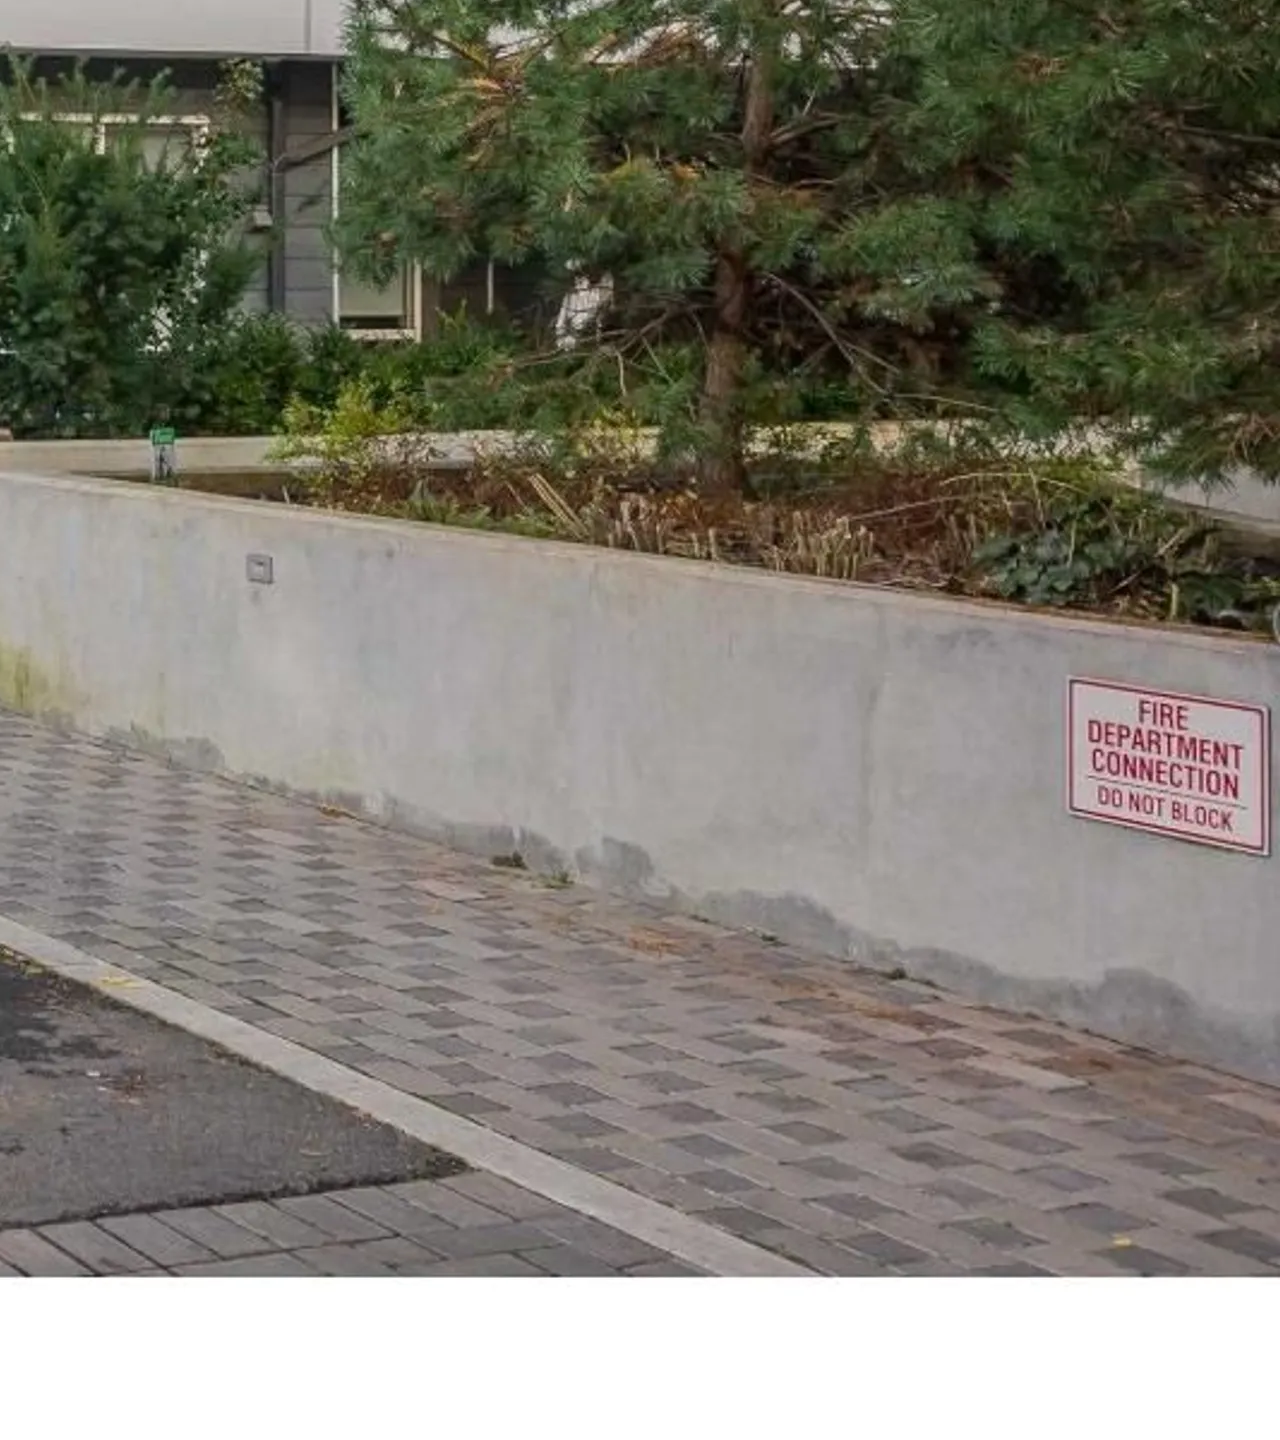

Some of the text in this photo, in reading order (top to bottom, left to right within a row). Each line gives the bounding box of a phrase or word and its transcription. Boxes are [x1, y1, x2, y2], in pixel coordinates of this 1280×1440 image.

[1139, 700, 1188, 730] FIRE
[1088, 720, 1245, 769] DEPARTMENT
[1092, 748, 1239, 800] CONNECTION
[1098, 785, 1233, 832] DO NOT BLOCK
